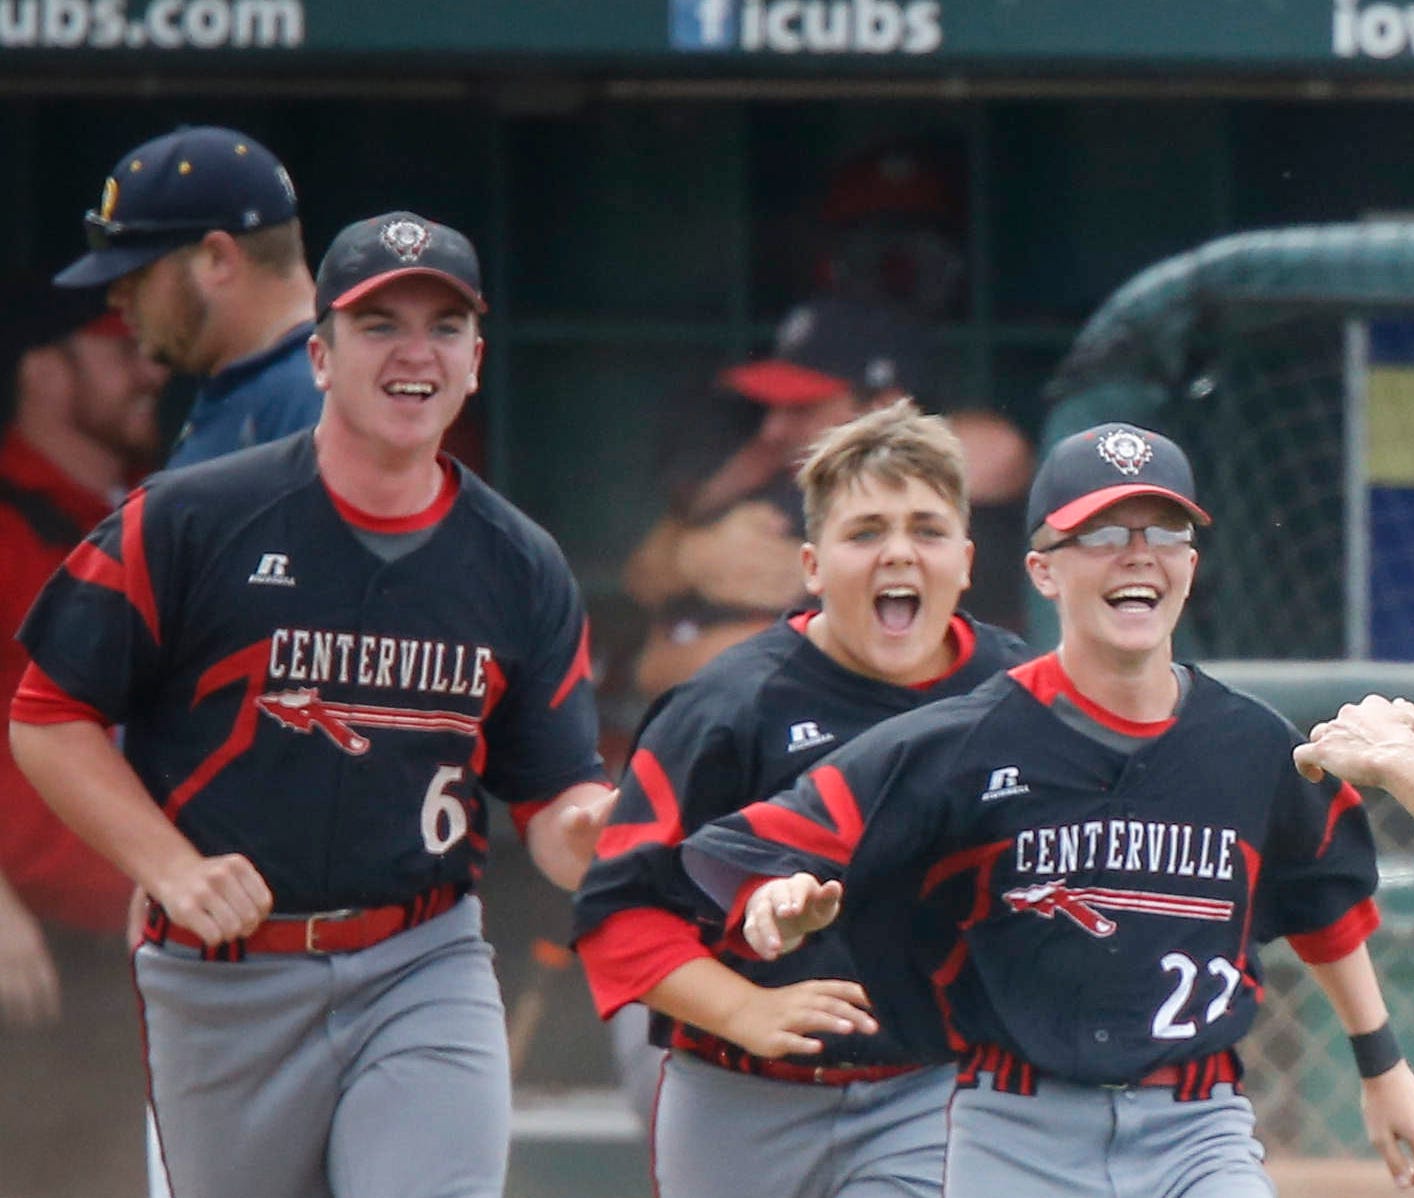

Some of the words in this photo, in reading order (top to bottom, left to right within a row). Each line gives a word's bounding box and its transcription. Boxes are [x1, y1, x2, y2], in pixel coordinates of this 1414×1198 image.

[741, 0, 942, 52] icubs
[268, 628, 493, 698] CENTERVILLE
[420, 764, 468, 855] 6
[1016, 819, 1237, 880] CENTERVILLE
